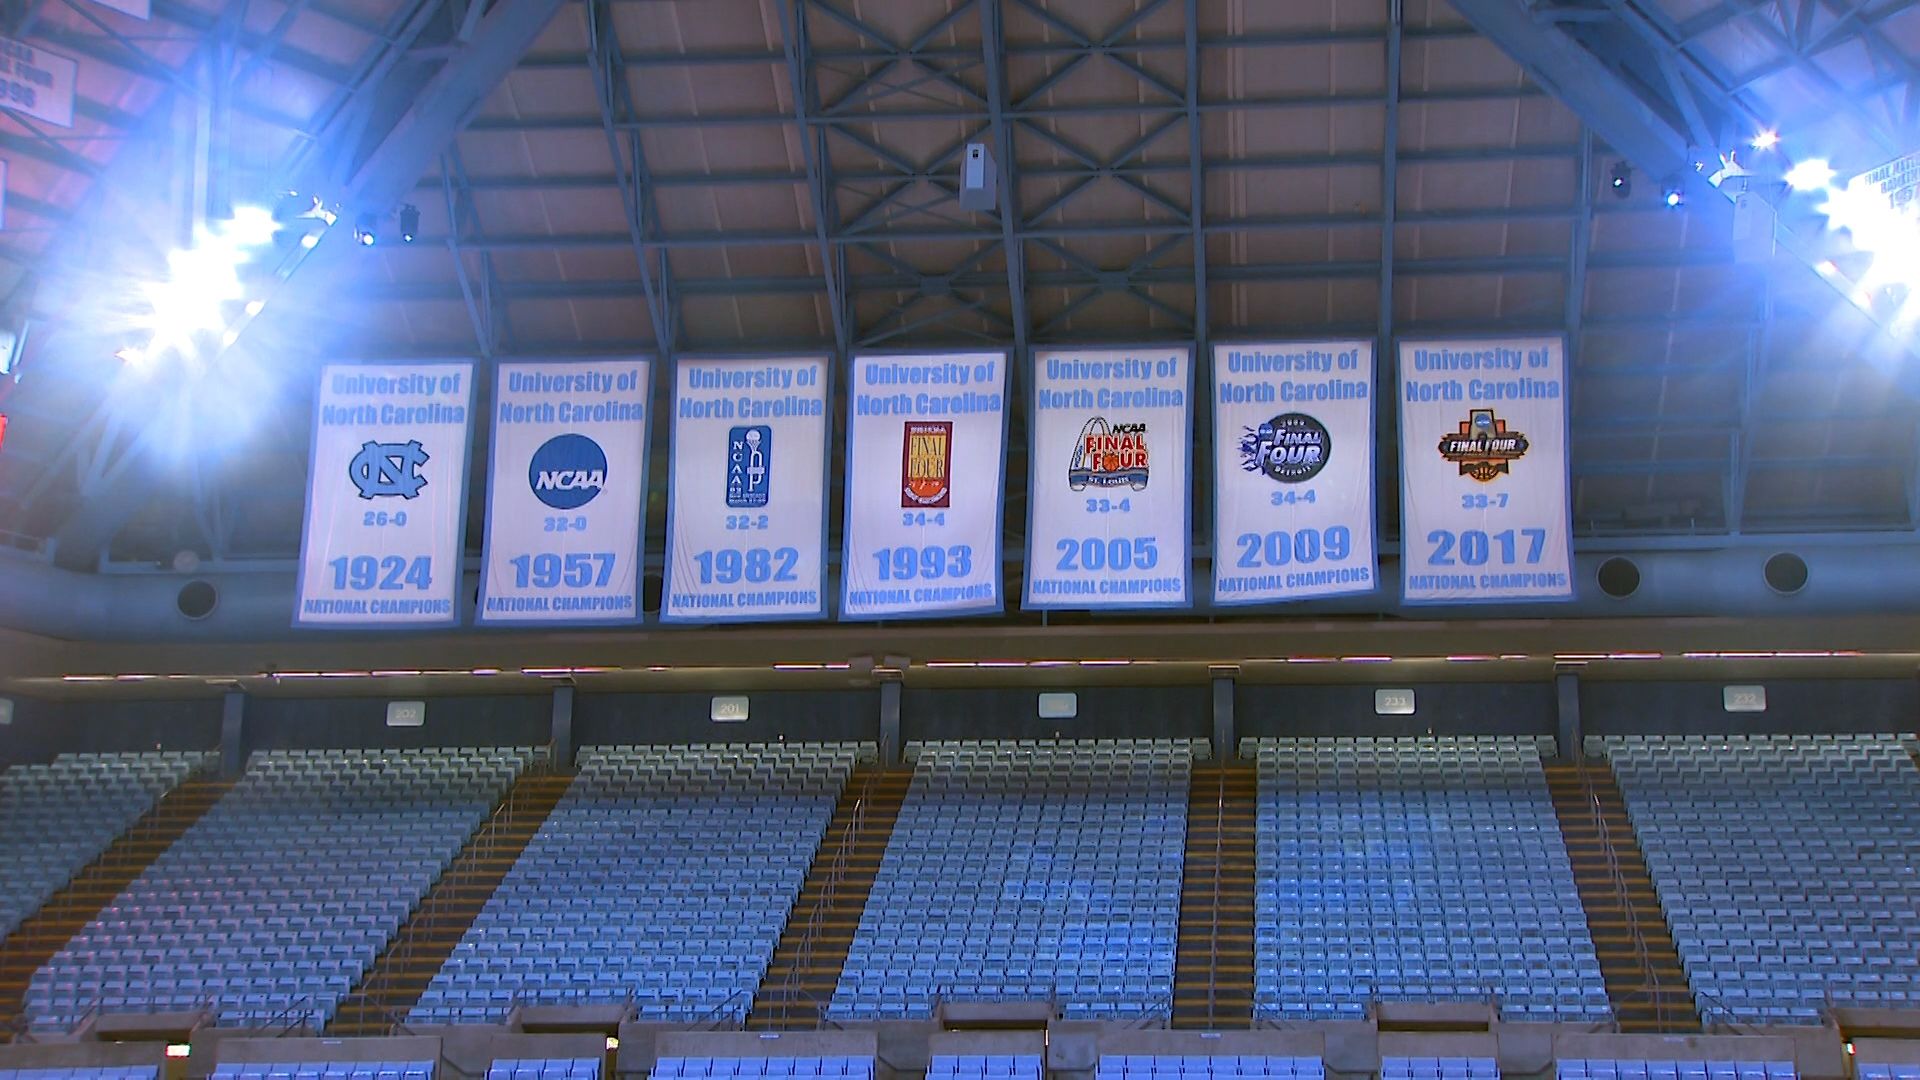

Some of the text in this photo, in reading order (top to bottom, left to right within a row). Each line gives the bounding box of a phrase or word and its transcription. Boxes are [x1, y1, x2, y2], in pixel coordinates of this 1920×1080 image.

[1046, 356, 1177, 380] University of
[1228, 349, 1359, 373] University of
[1414, 347, 1549, 371] University of
[509, 369, 638, 394] University of
[689, 365, 818, 389] University of
[865, 360, 995, 385] University of
[332, 373, 460, 396] University of
[1220, 379, 1368, 404] North Carolina
[1406, 378, 1560, 402] North Carolina
[680, 396, 822, 418] North Carolina
[857, 392, 1001, 416] North Carolina
[1039, 387, 1183, 409] North Carolina
[322, 403, 465, 425] North Carolina
[500, 401, 643, 424] North Carolina
[1112, 423, 1146, 434] NCAA
[1085, 433, 1146, 454] FINAL
[1449, 439, 1516, 453] FINAL FOUR
[730, 440, 744, 484] NCAA
[535, 469, 603, 490] NCAA
[1086, 498, 1130, 513] 33-4
[1271, 489, 1316, 506] 34-4
[1461, 493, 1509, 509] 33-7
[363, 511, 407, 527] 26-0
[543, 516, 587, 532] 32-0
[726, 515, 769, 530] 32-2
[902, 512, 945, 526] 34-4
[1056, 536, 1158, 571] 2005
[1236, 525, 1350, 568] 2009
[1427, 528, 1546, 566] 2017
[329, 555, 432, 590] 1924
[510, 553, 616, 588] 1957
[694, 547, 799, 584] 1982
[872, 545, 972, 580] 1993
[1033, 577, 1181, 594] NATIONAL CHAMPIONS
[1218, 567, 1369, 592] NATIONAL CHAMPIONS
[1409, 573, 1567, 590] NATIONAL CHAMPIONS
[487, 595, 632, 612] NATIONAL CHAMPIONS
[672, 590, 817, 608] NATIONAL CHAMPIONS
[850, 583, 992, 605] NATIONAL CHAMPIONS
[304, 599, 450, 614] NATIONAL CHAMPIONS
[720, 703, 739, 714] 201
